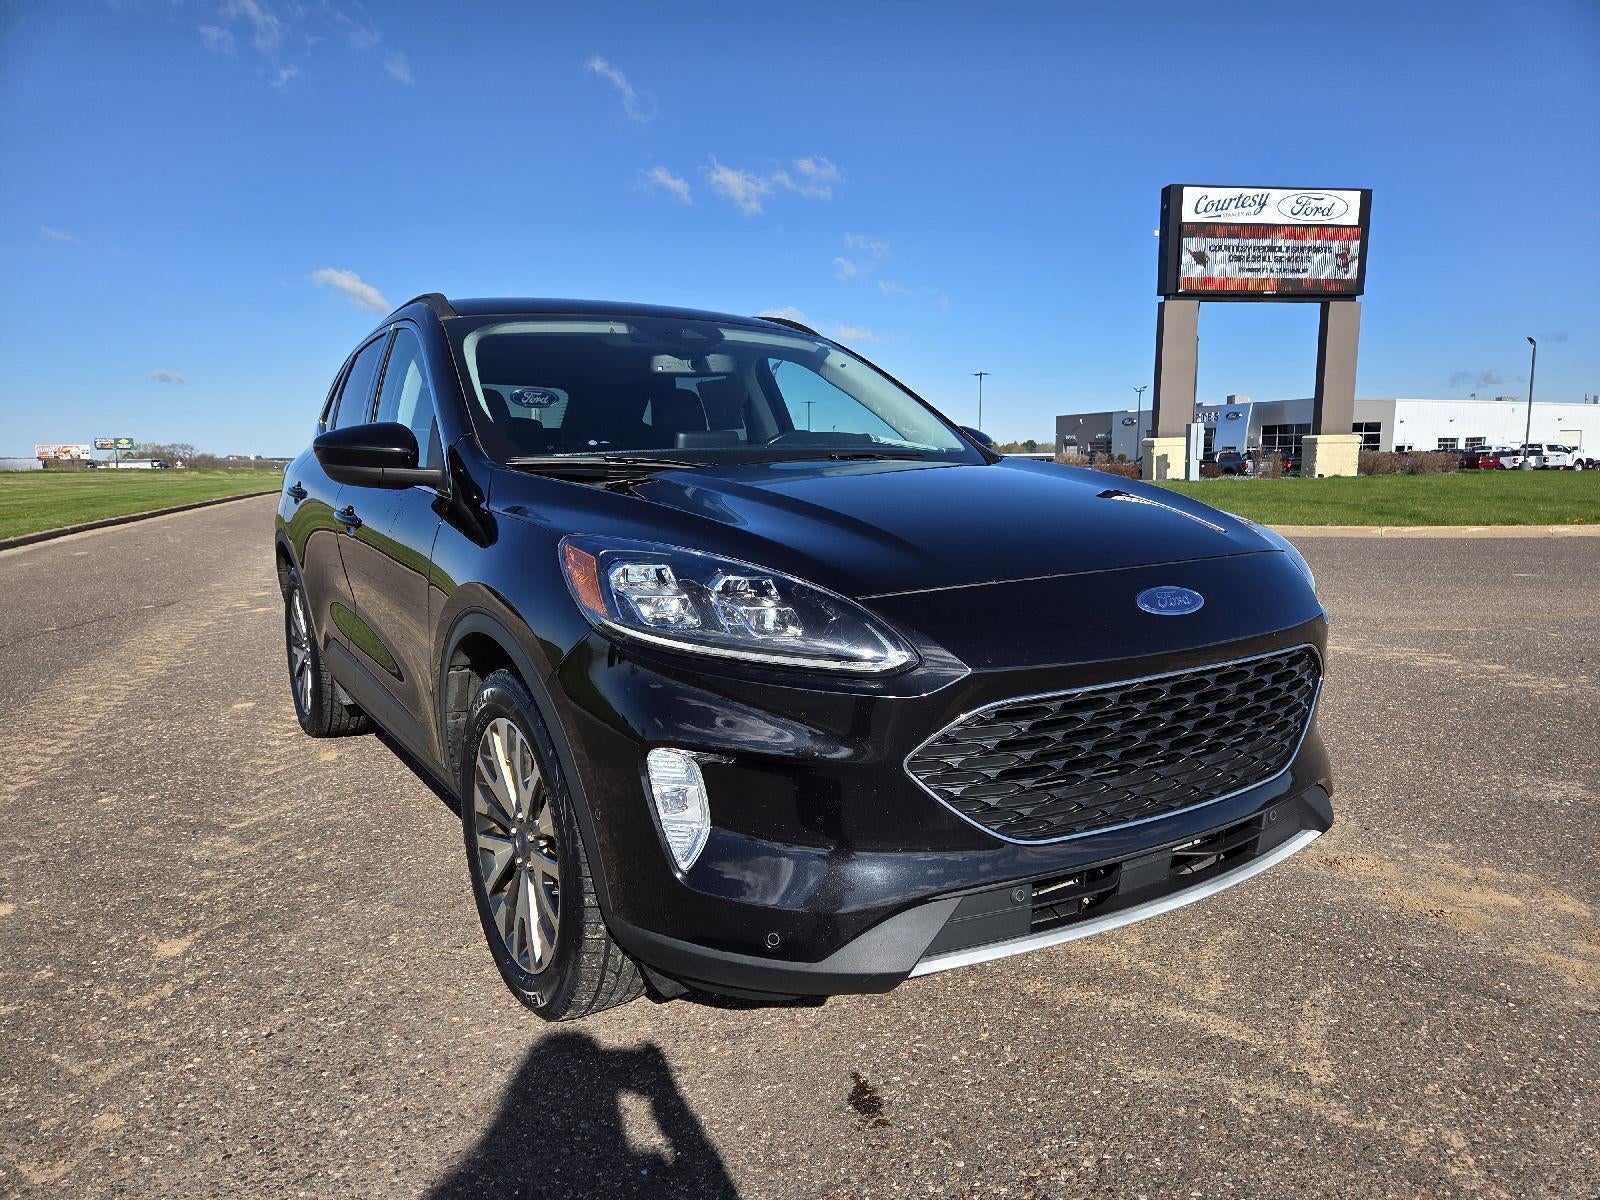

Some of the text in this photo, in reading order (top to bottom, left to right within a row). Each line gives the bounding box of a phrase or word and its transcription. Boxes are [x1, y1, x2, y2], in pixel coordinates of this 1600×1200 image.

[1194, 192, 1270, 216] Courtesy
[1290, 196, 1335, 217] Ford
[521, 391, 550, 404] Ford
[1155, 590, 1192, 609] Ford
